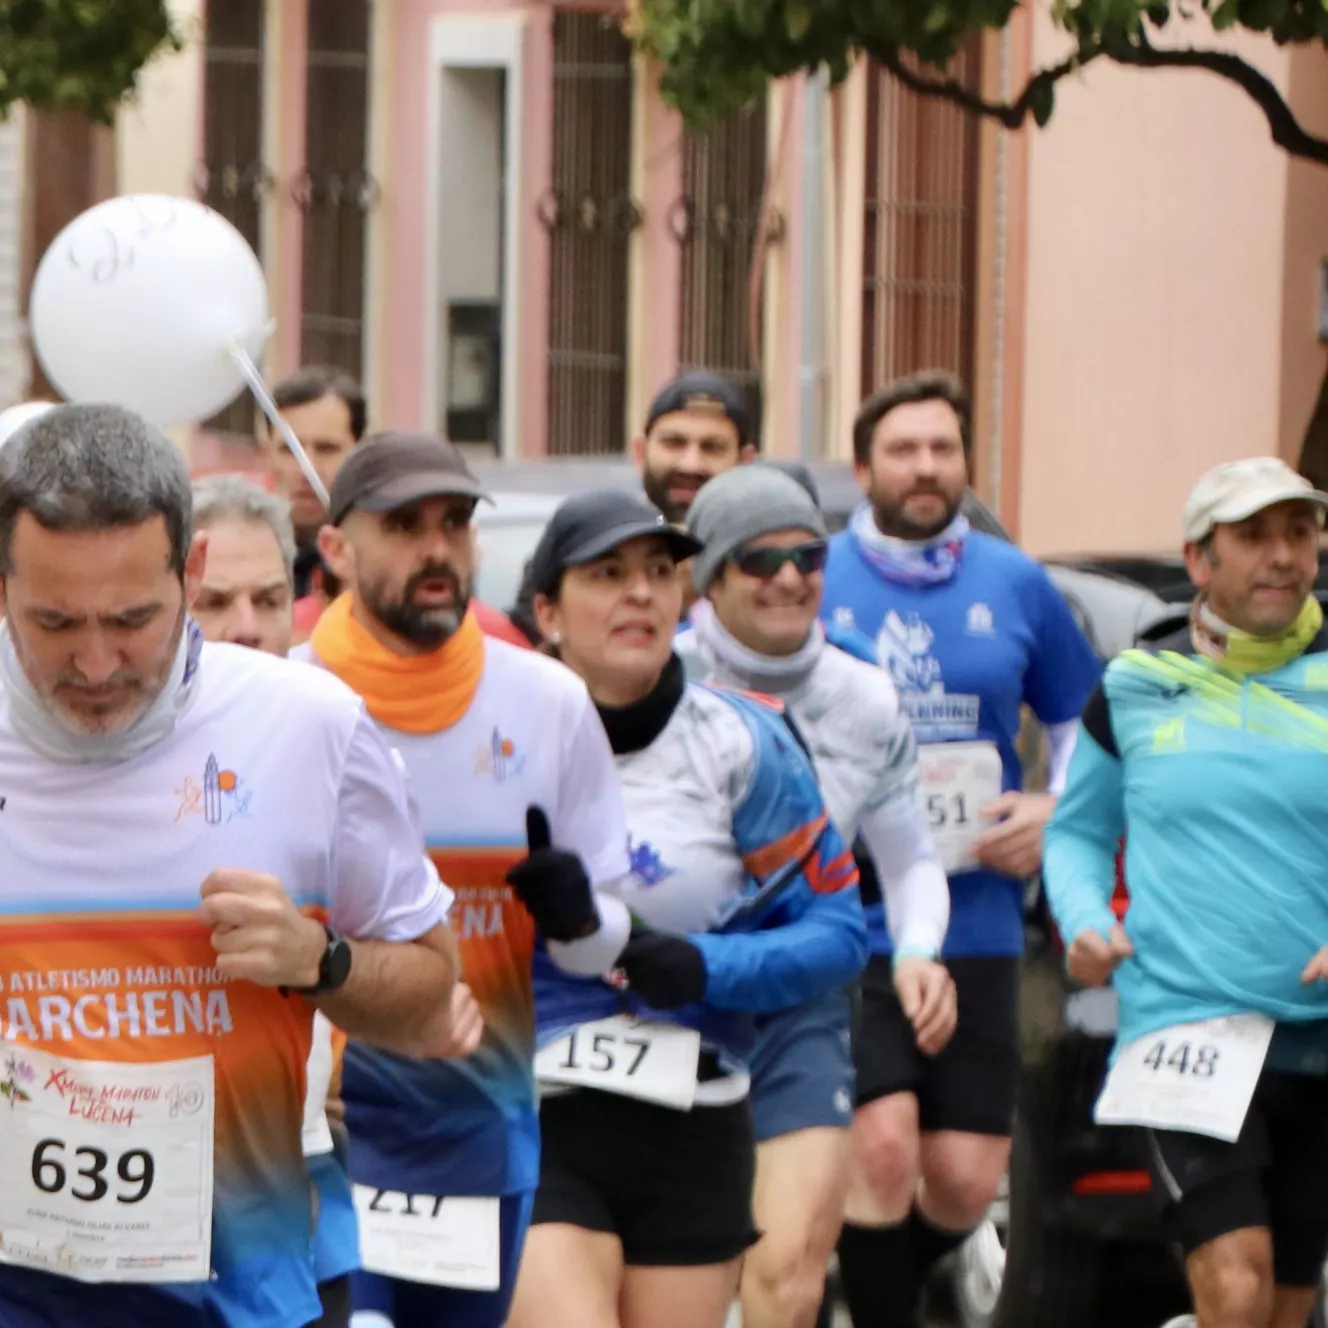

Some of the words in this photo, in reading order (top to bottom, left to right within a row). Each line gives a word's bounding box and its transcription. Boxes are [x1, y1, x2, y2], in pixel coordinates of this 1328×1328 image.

[926, 792, 969, 827] 51
[10, 967, 120, 992] ATLETISMO
[558, 1032, 652, 1076] 157
[1144, 1040, 1220, 1077] 448
[69, 1096, 135, 1127] LUCENA
[31, 1138, 154, 1203] 639
